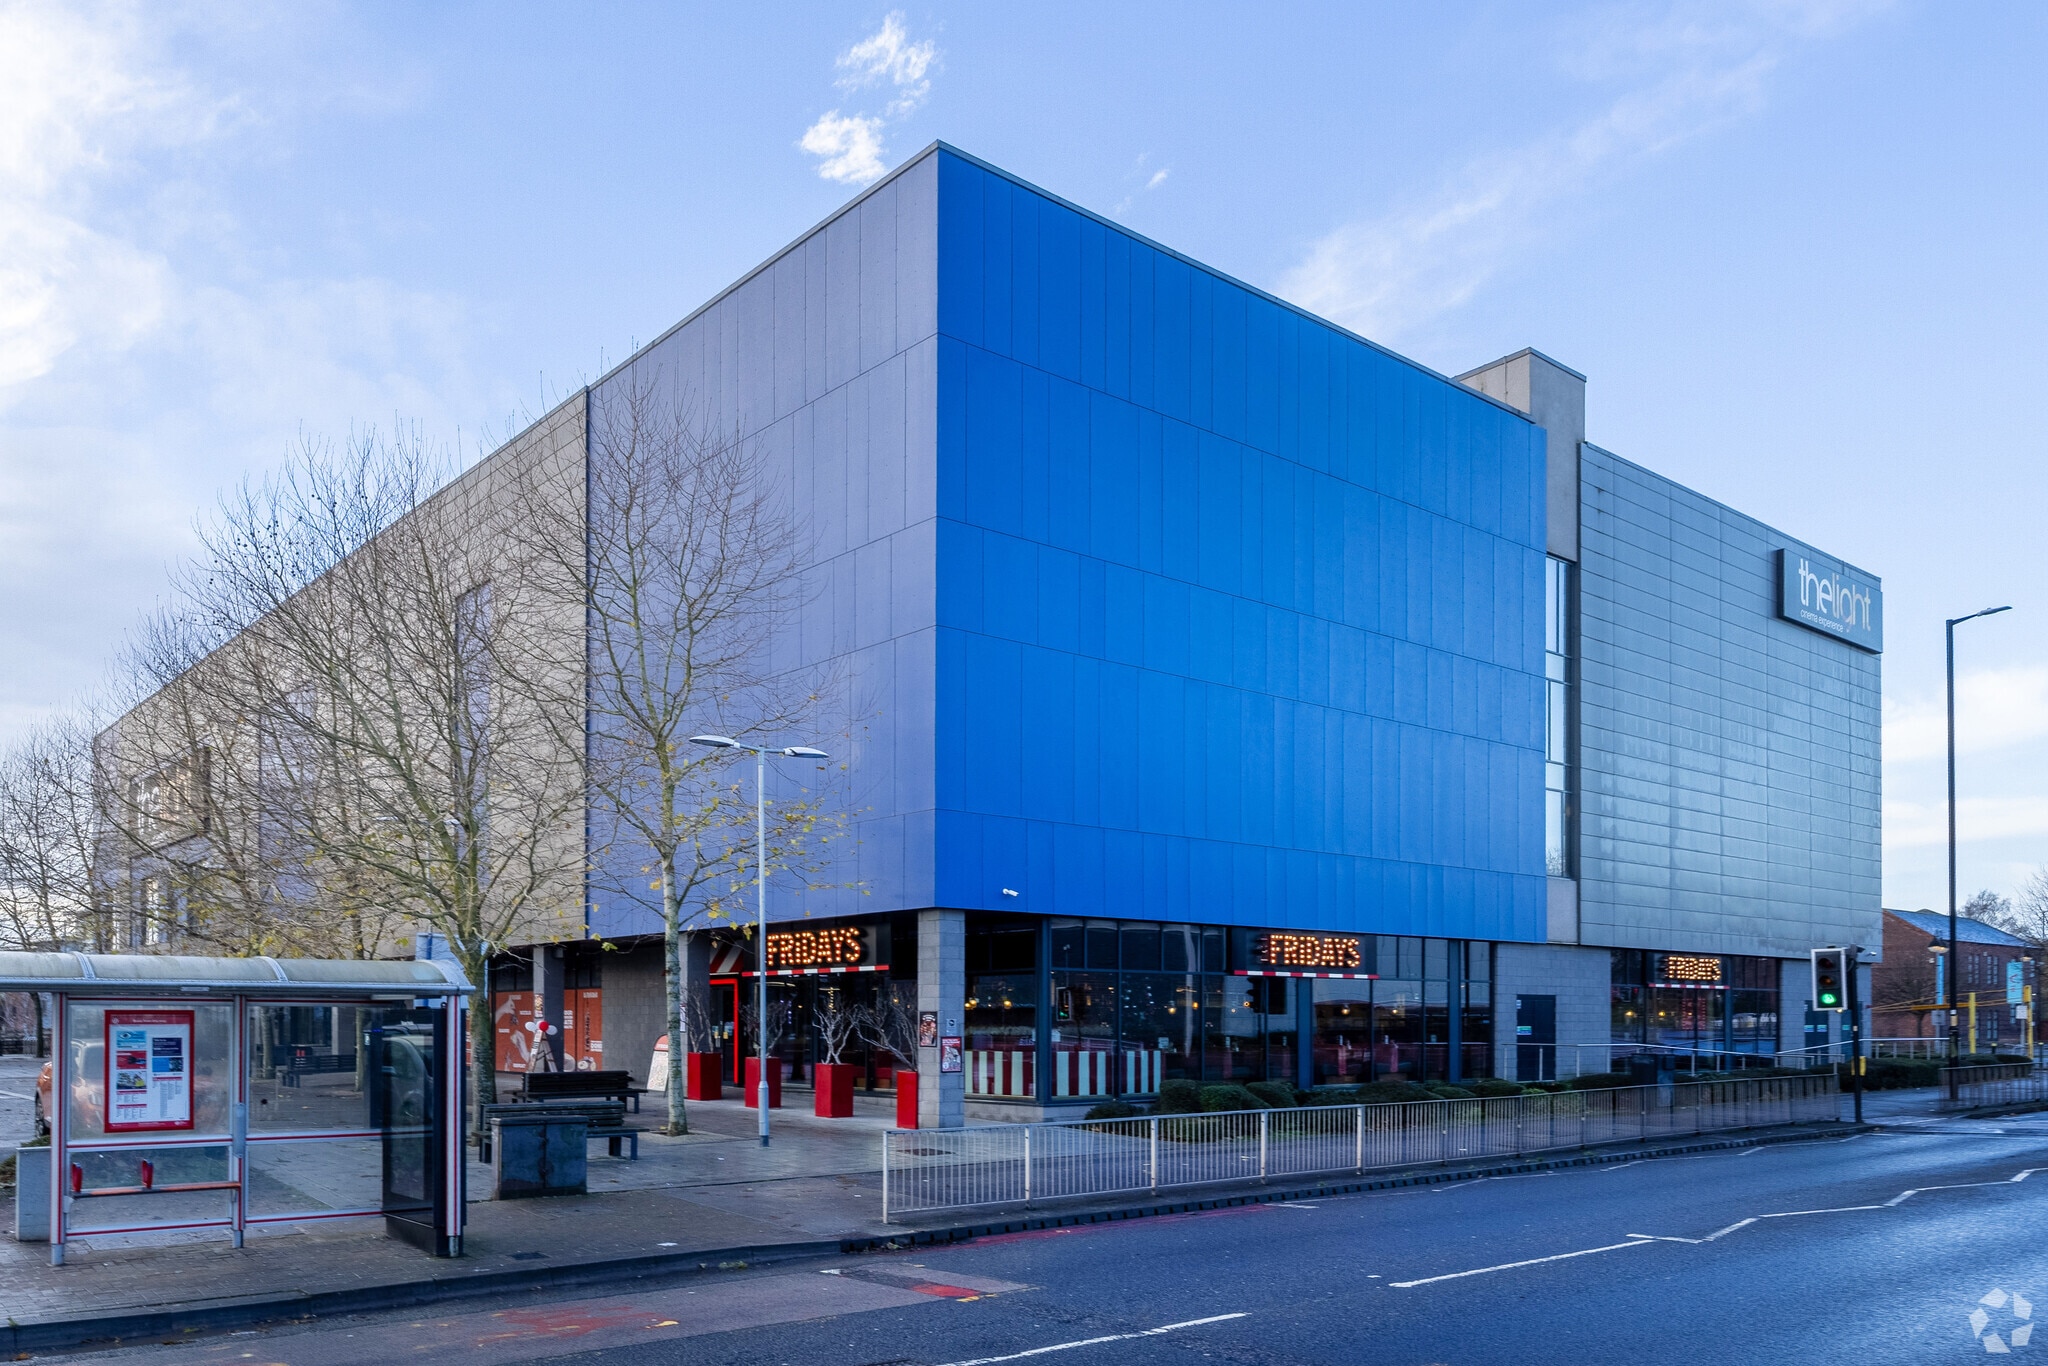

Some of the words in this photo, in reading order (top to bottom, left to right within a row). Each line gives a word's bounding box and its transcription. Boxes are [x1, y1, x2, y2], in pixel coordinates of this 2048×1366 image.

[766, 926, 860, 966] FRIDAYS
[1268, 934, 1360, 967] FRIDAYS
[1667, 955, 1721, 980] FRIDAYS
